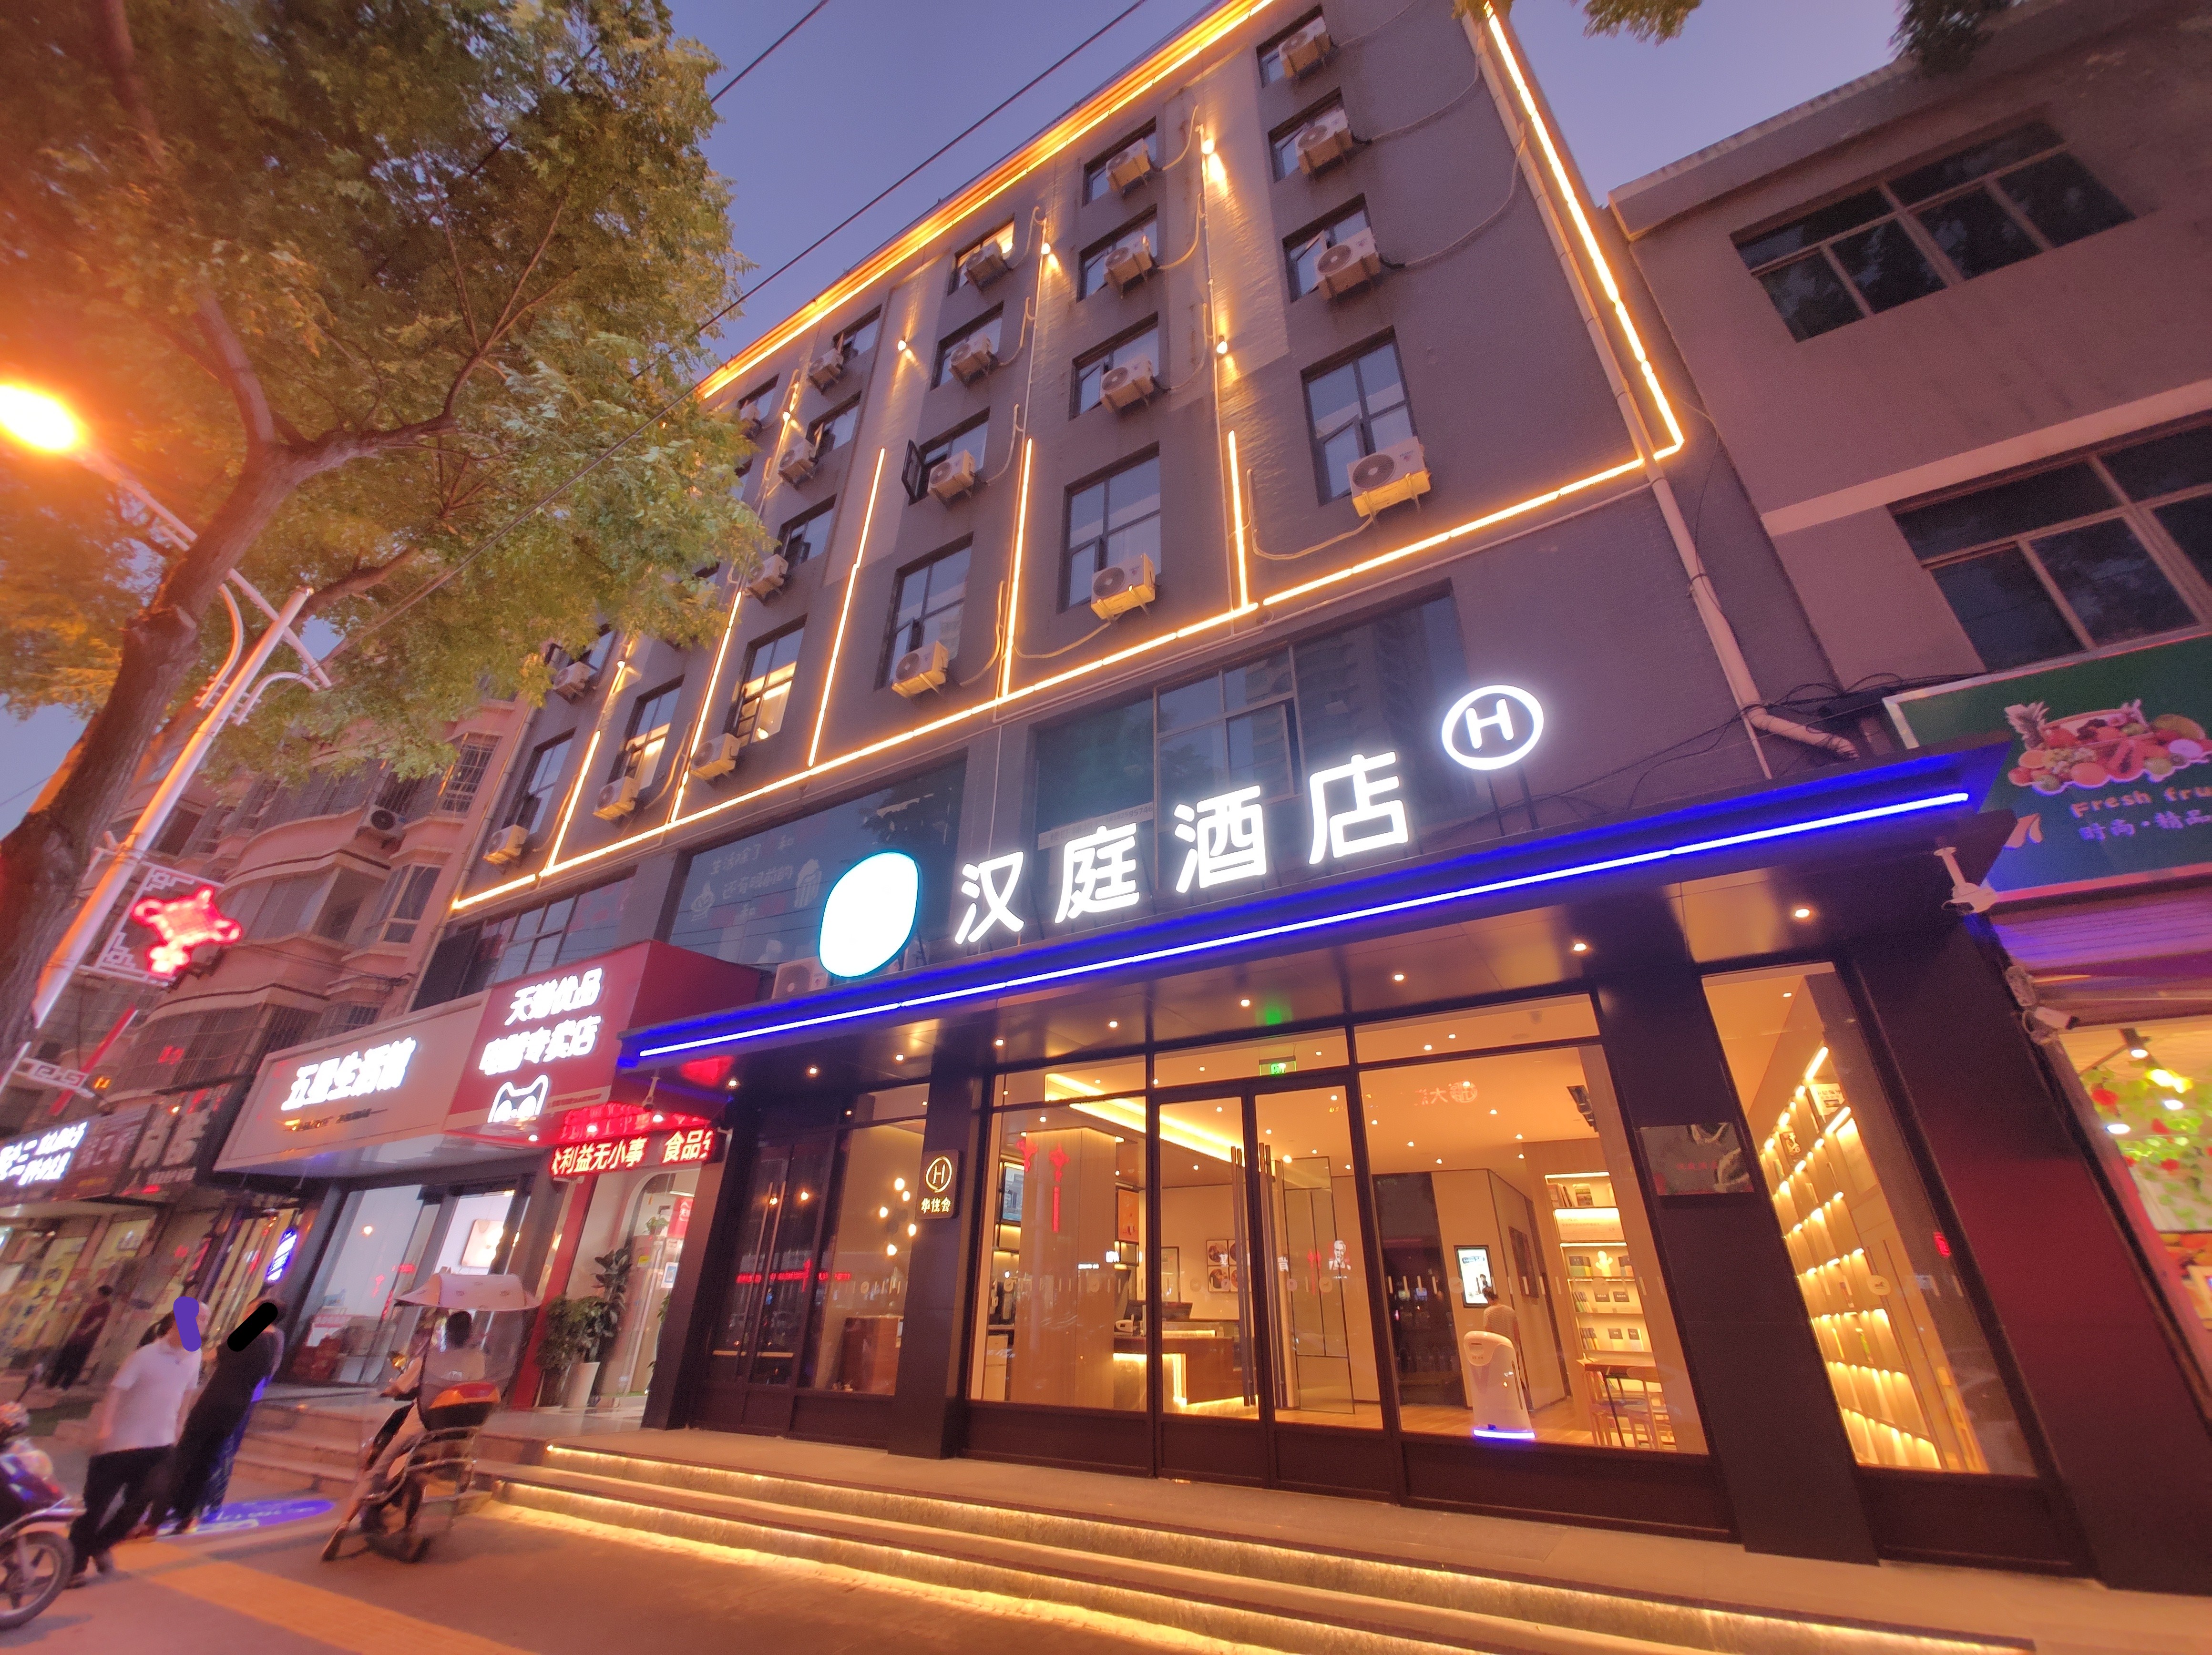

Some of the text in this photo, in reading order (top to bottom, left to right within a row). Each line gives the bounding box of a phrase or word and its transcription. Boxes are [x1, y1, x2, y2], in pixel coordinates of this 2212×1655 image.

[955, 750, 1409, 945] 汉庭酒店
[2070, 790, 2152, 818] Fresh
